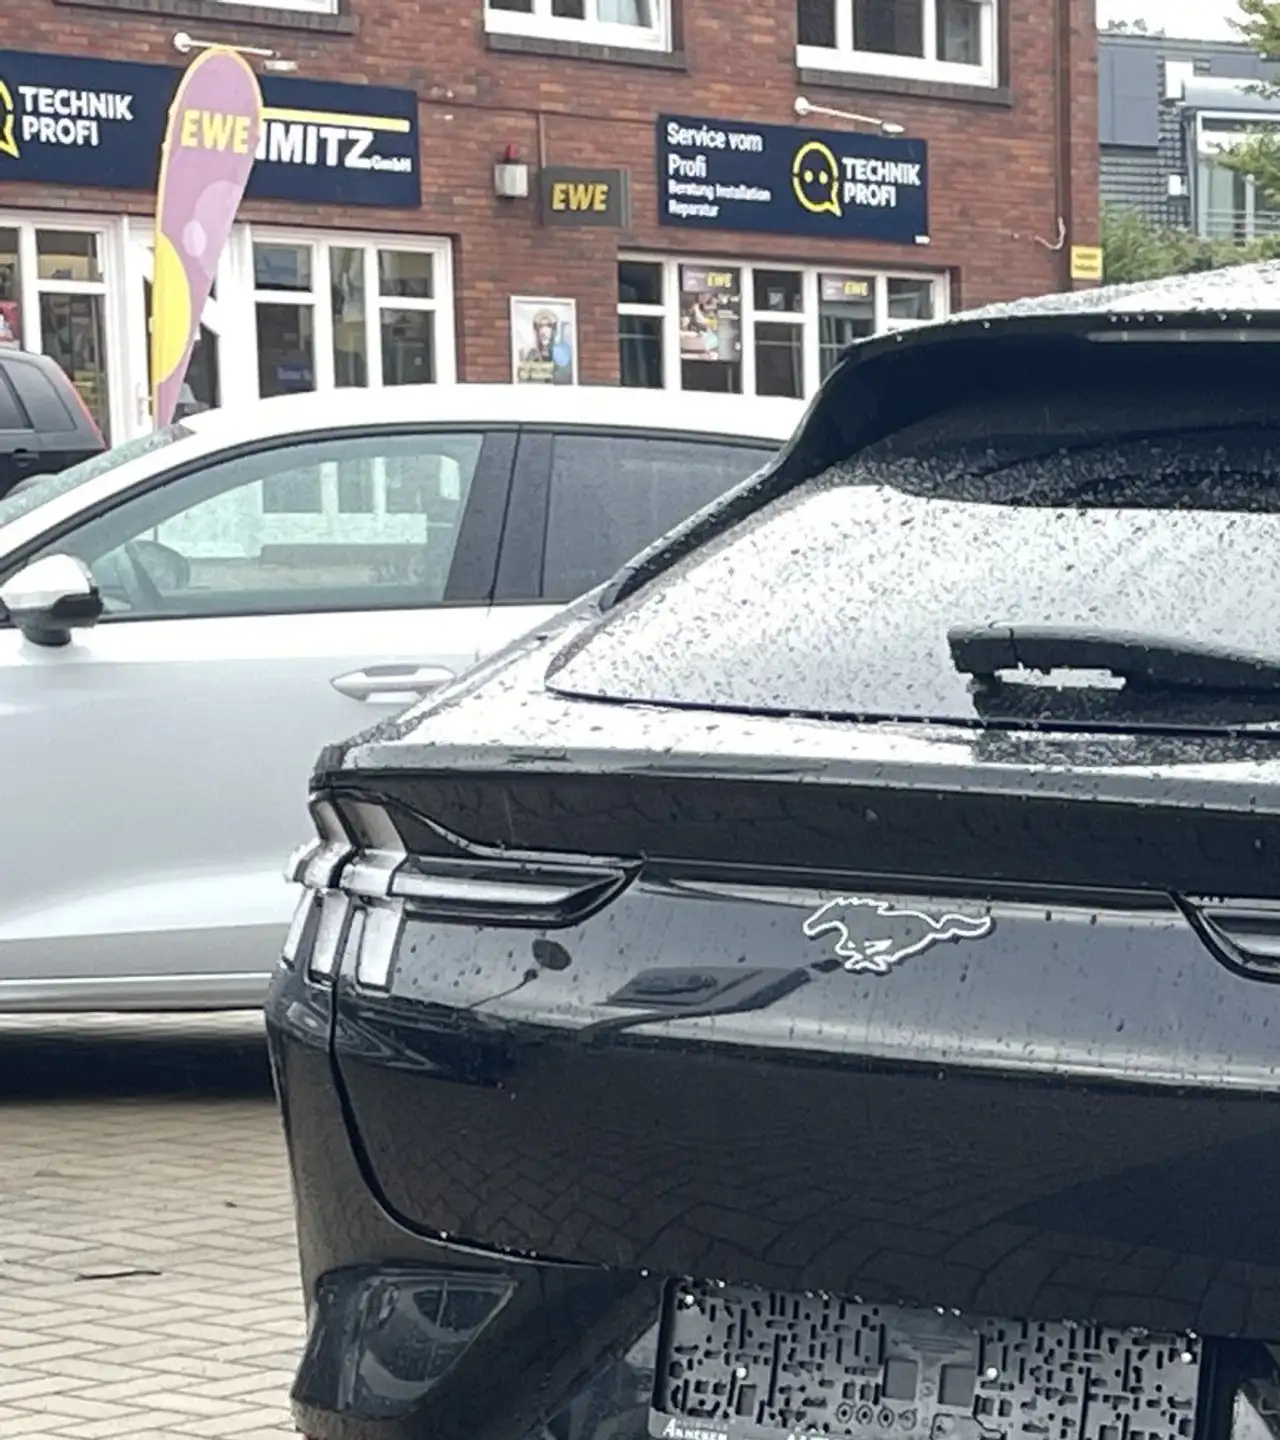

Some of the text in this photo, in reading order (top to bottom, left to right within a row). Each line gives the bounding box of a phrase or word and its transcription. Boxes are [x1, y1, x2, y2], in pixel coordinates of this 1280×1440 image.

[18, 86, 134, 120] TECHNIK
[22, 115, 100, 146] PROFI
[181, 110, 251, 153] EWE
[667, 122, 763, 151] Service vom
[668, 154, 707, 178] Profi
[841, 157, 922, 186] TECHNIK
[552, 183, 609, 212] EWE
[844, 182, 897, 207] PROFI
